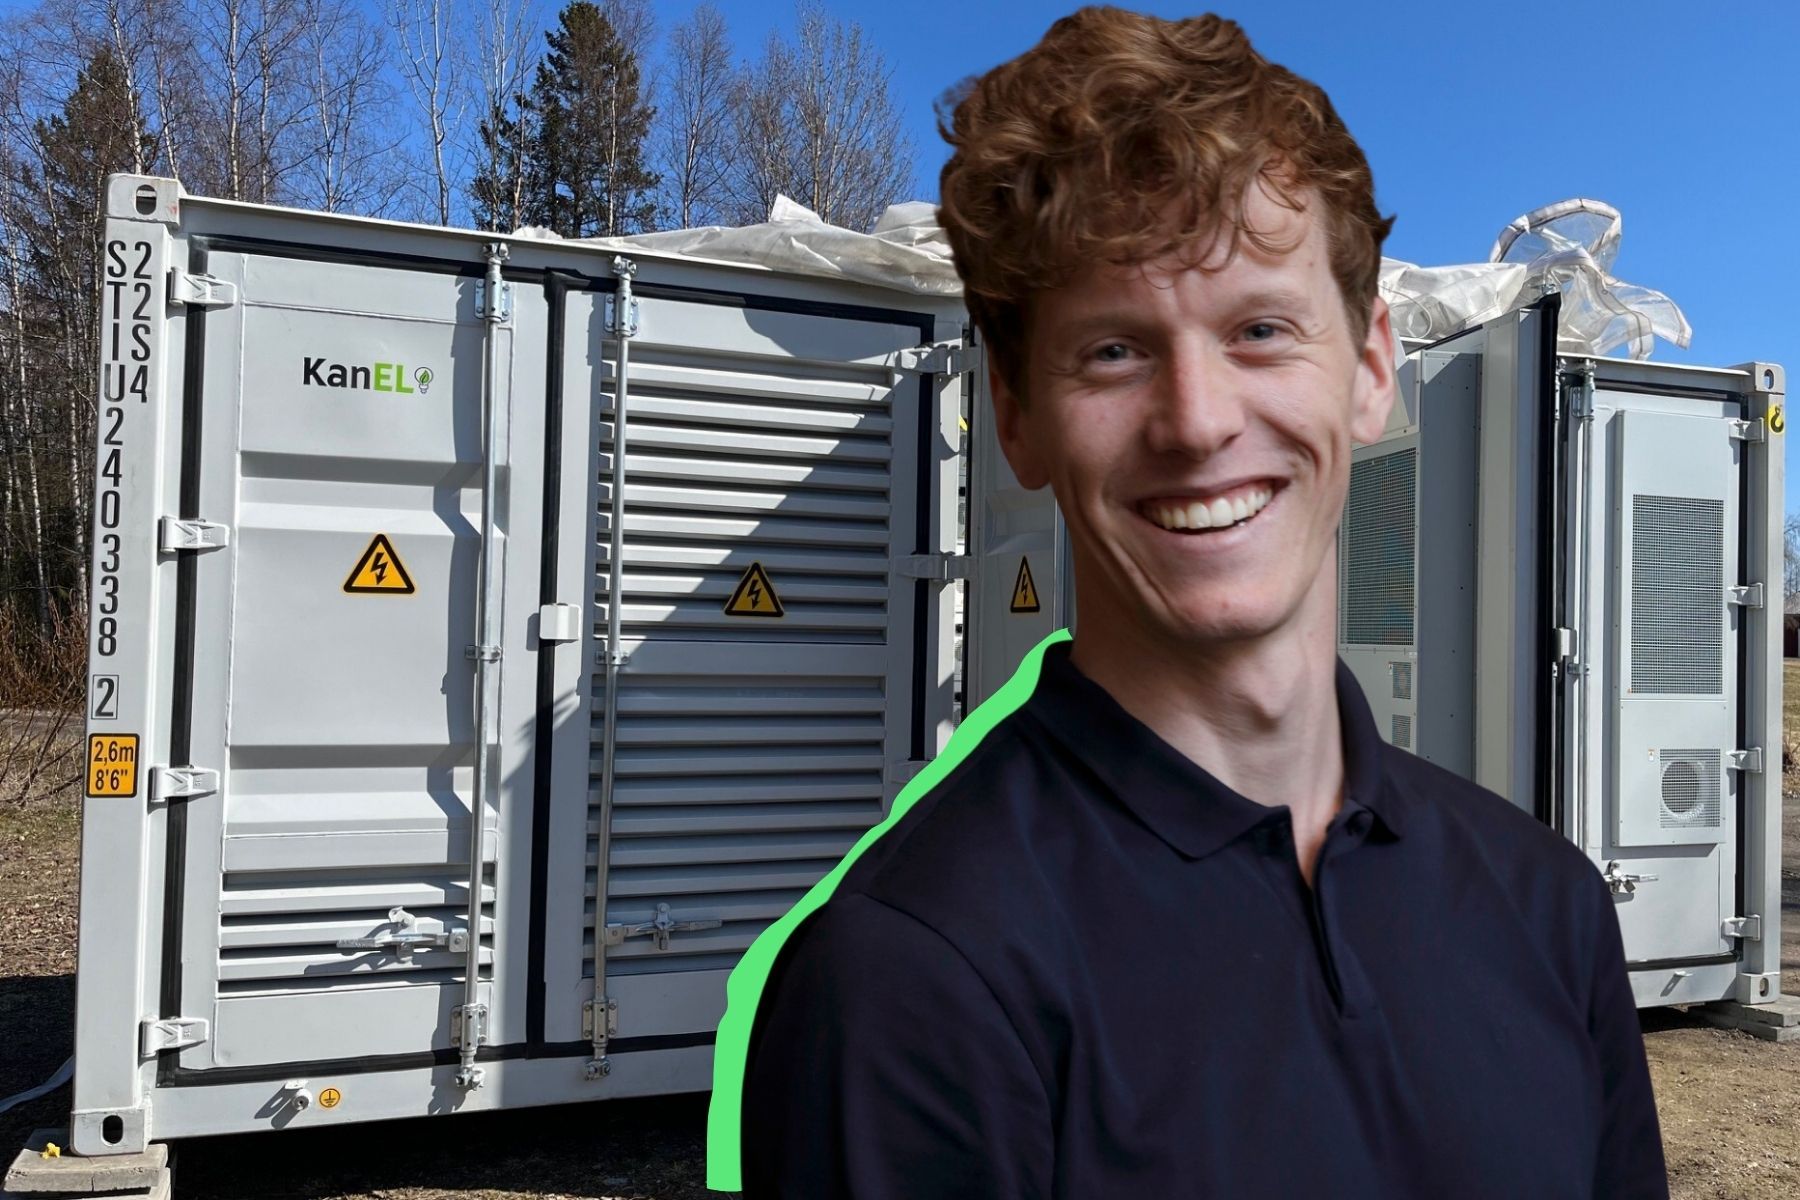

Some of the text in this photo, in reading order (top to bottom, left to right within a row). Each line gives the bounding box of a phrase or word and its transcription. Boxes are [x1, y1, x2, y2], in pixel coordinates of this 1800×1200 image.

[130, 240, 152, 403] 22S4
[303, 356, 414, 394] KanEL
[95, 677, 114, 717] 2
[93, 740, 134, 766] 2,6m
